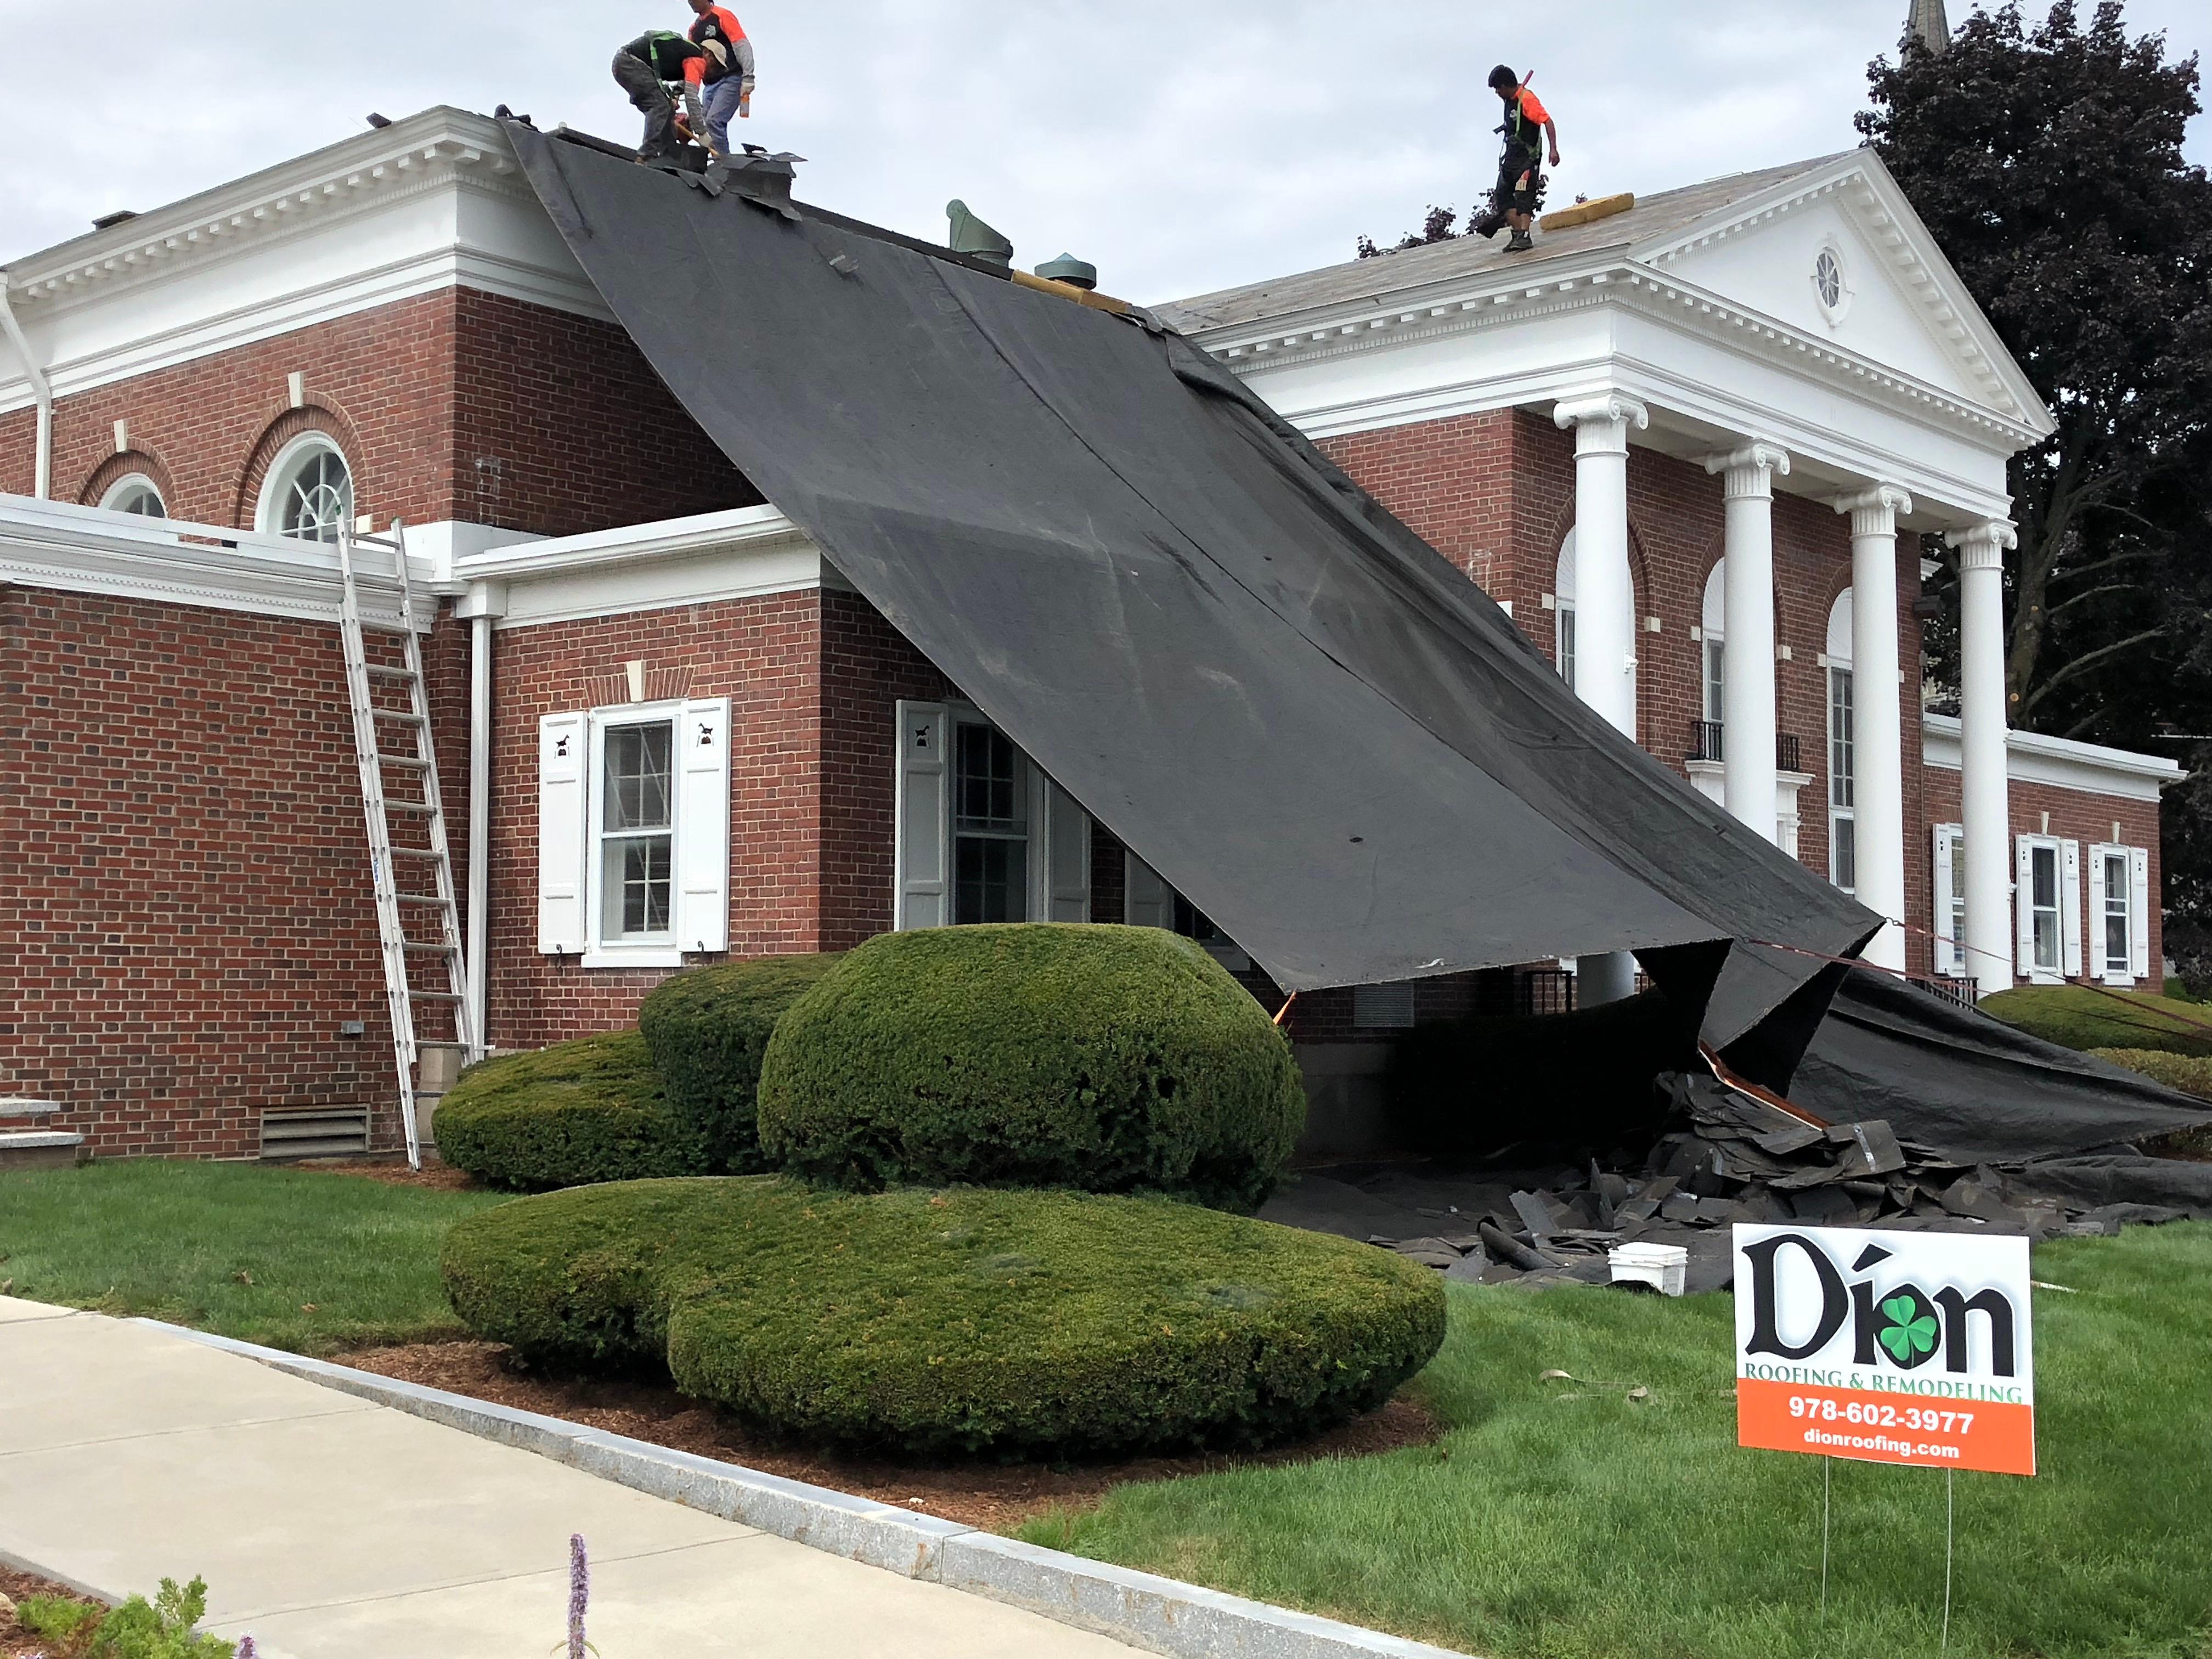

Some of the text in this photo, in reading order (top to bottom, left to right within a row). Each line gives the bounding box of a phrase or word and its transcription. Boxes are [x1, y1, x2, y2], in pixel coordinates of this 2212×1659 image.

[1745, 1363, 2022, 1404] ROOFING & REMODELING
[1789, 1396, 1974, 1435] 978-602-3977
[1803, 1428, 1960, 1458] dionroofing.com
